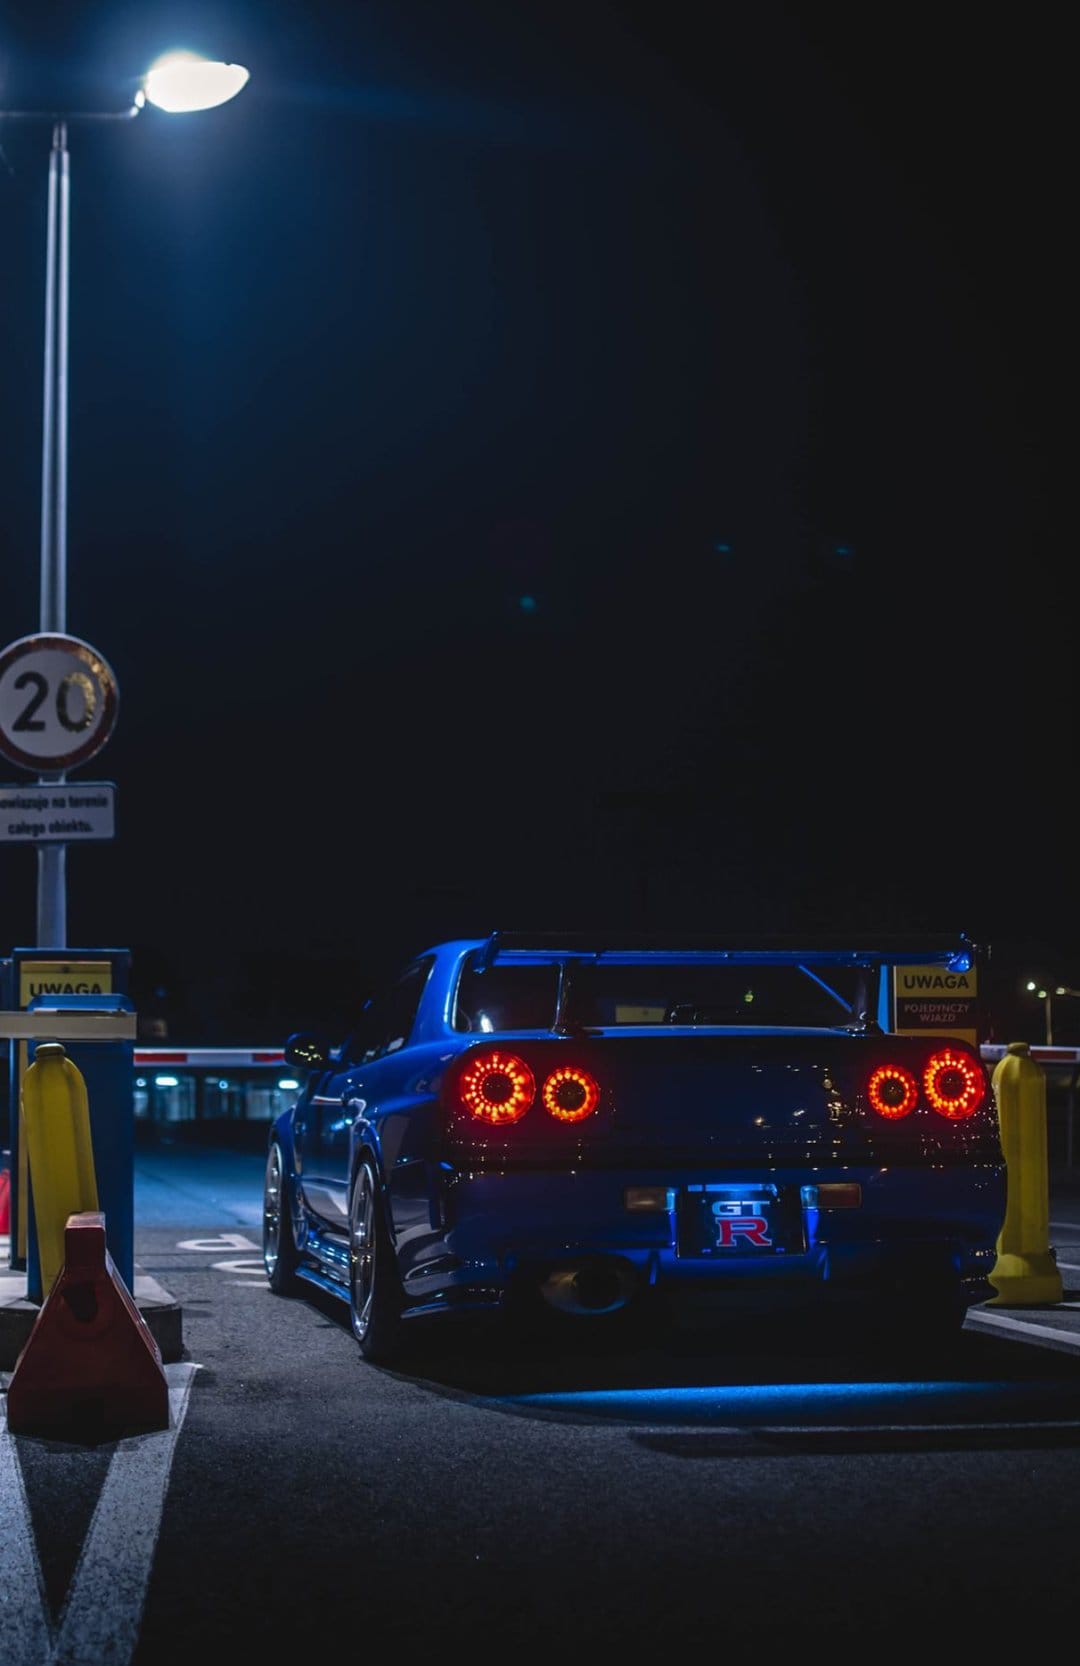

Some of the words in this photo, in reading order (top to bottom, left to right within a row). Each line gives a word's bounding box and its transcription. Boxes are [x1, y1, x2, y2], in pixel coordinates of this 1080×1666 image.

[12, 671, 96, 733] 20
[904, 975, 969, 989] UWAGA
[30, 983, 102, 996] UWAGA
[904, 1003, 969, 1013] POJEDYNCZY
[920, 1014, 956, 1022] WJAZD
[711, 1200, 771, 1216] GT
[714, 1216, 773, 1248] R
